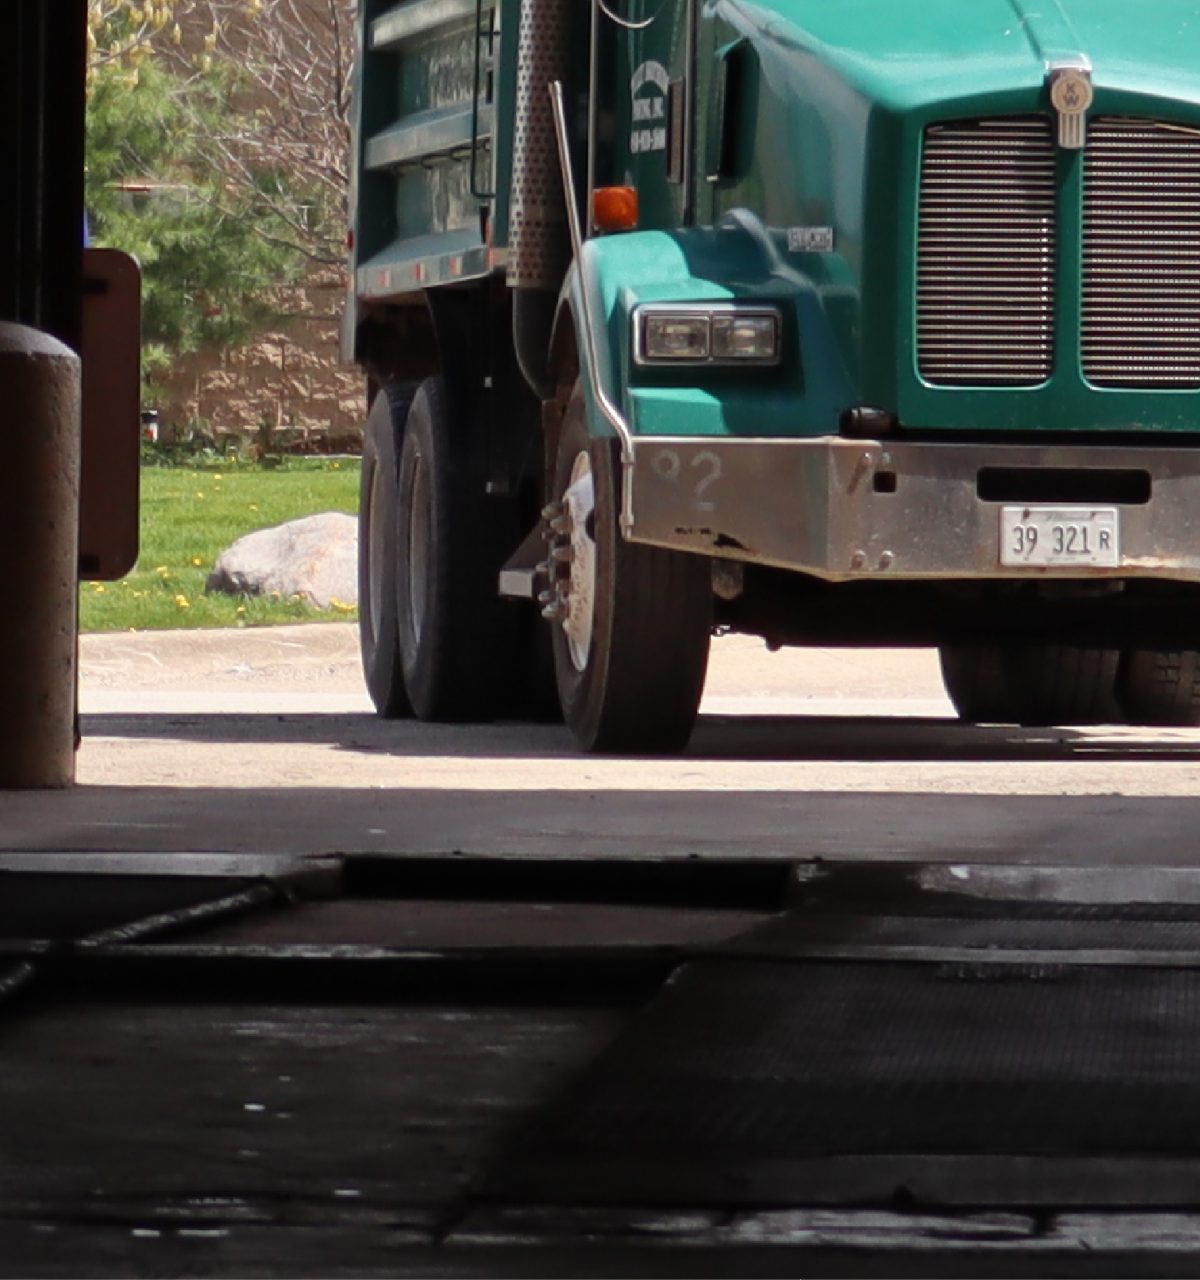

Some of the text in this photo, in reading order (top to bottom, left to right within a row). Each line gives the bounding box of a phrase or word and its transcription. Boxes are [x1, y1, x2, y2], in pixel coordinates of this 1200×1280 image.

[1013, 526, 1109, 556] 39 321 R
